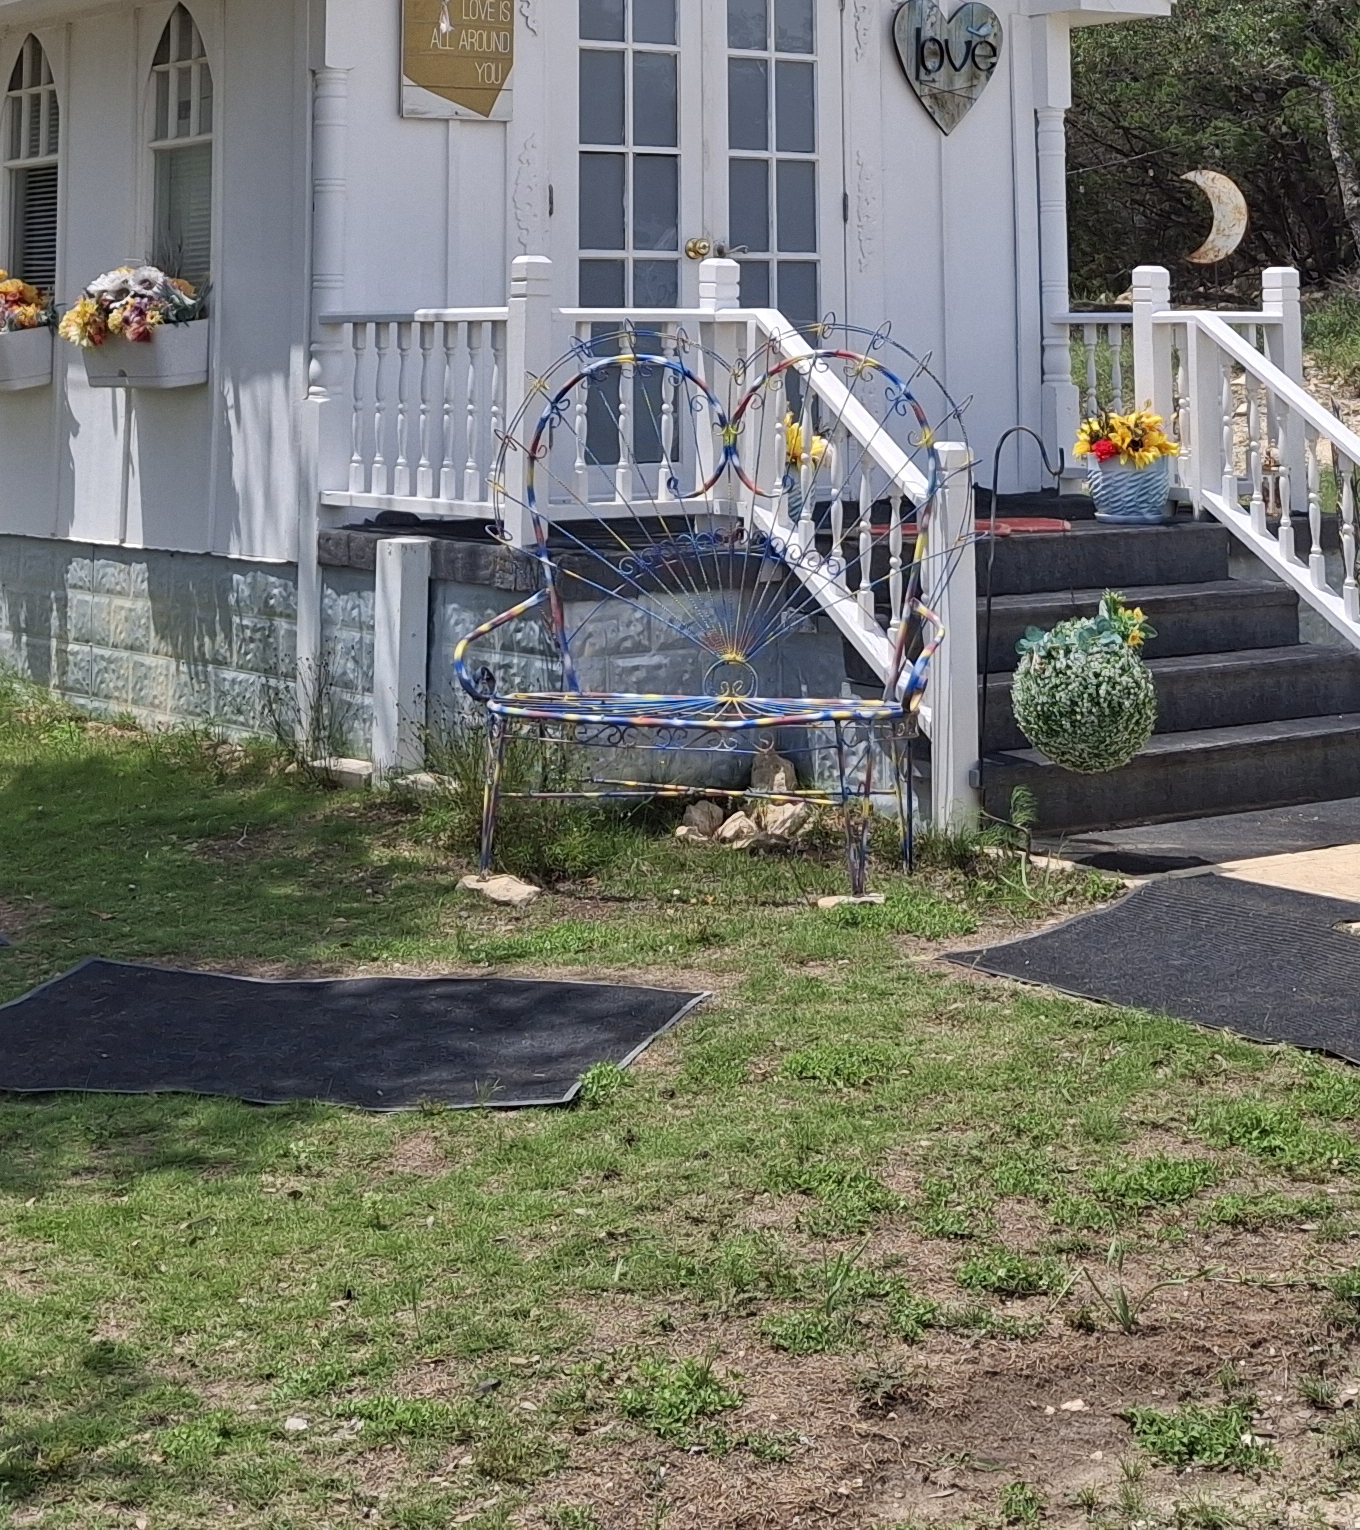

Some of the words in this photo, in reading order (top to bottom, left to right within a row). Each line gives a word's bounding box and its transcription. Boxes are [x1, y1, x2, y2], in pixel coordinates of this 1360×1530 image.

[499, 0, 511, 22] IS
[430, 27, 454, 50] ALL
[458, 29, 510, 53] AROUND
[915, 27, 997, 80] love
[474, 61, 502, 85] YOU
